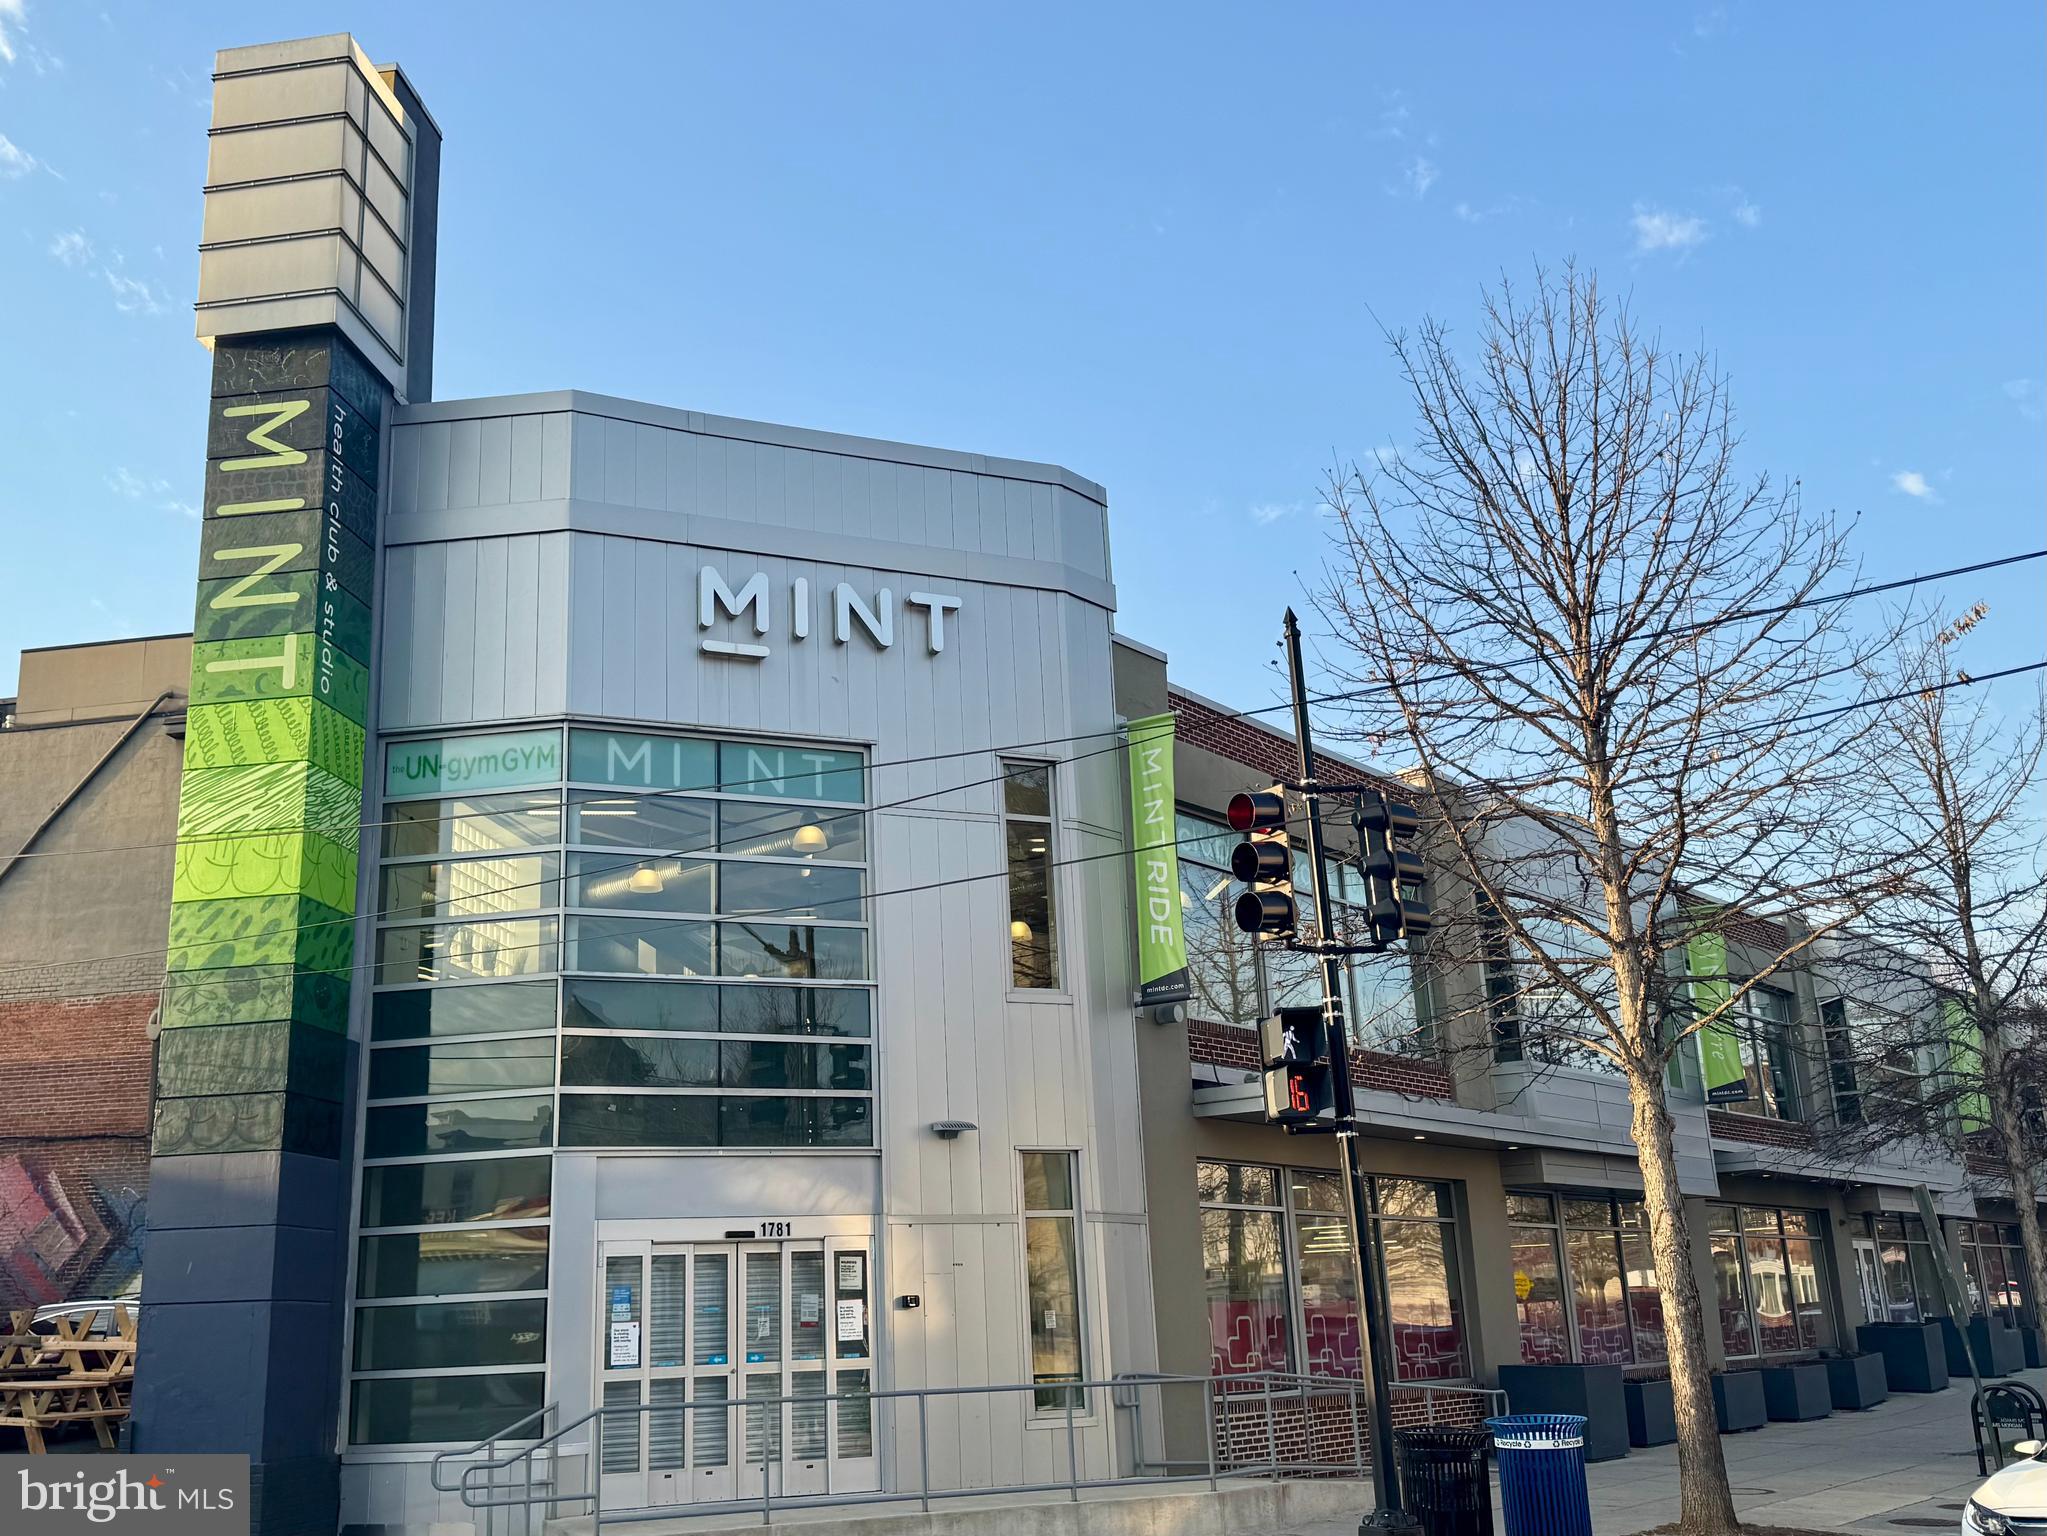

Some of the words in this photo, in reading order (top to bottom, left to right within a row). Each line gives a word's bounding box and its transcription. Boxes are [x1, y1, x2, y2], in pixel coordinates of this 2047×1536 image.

[332, 404, 348, 493] health
[205, 400, 310, 689] MINT
[327, 502, 342, 563] club
[325, 573, 338, 591] &
[699, 565, 963, 657] MINT
[320, 601, 336, 694] studio
[392, 764, 405, 775] the
[607, 739, 835, 798] MINT
[1141, 747, 1166, 850] MINT
[1146, 860, 1174, 947] RIDE
[1146, 983, 1185, 993] mintdc.com
[760, 1222, 792, 1238] 1781
